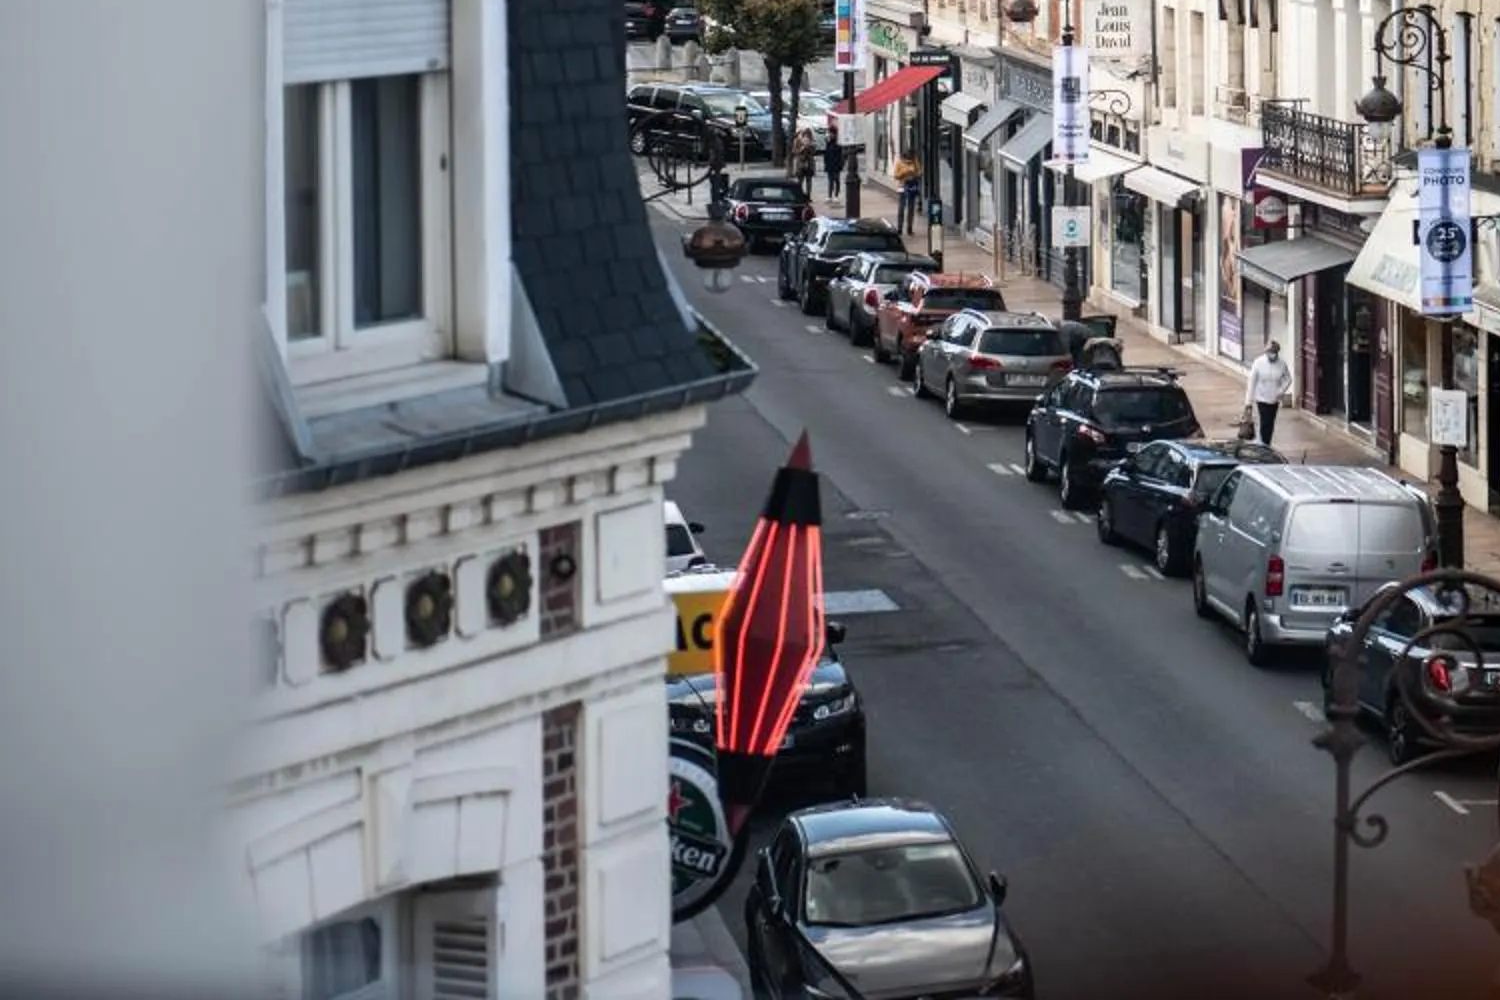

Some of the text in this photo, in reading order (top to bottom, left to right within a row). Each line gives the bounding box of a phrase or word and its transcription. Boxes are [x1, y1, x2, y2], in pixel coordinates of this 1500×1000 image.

[1097, 2, 1128, 17] Jean
[1095, 18, 1131, 32] Louis
[1095, 34, 1131, 49] David
[1423, 175, 1465, 186] PHOTO
